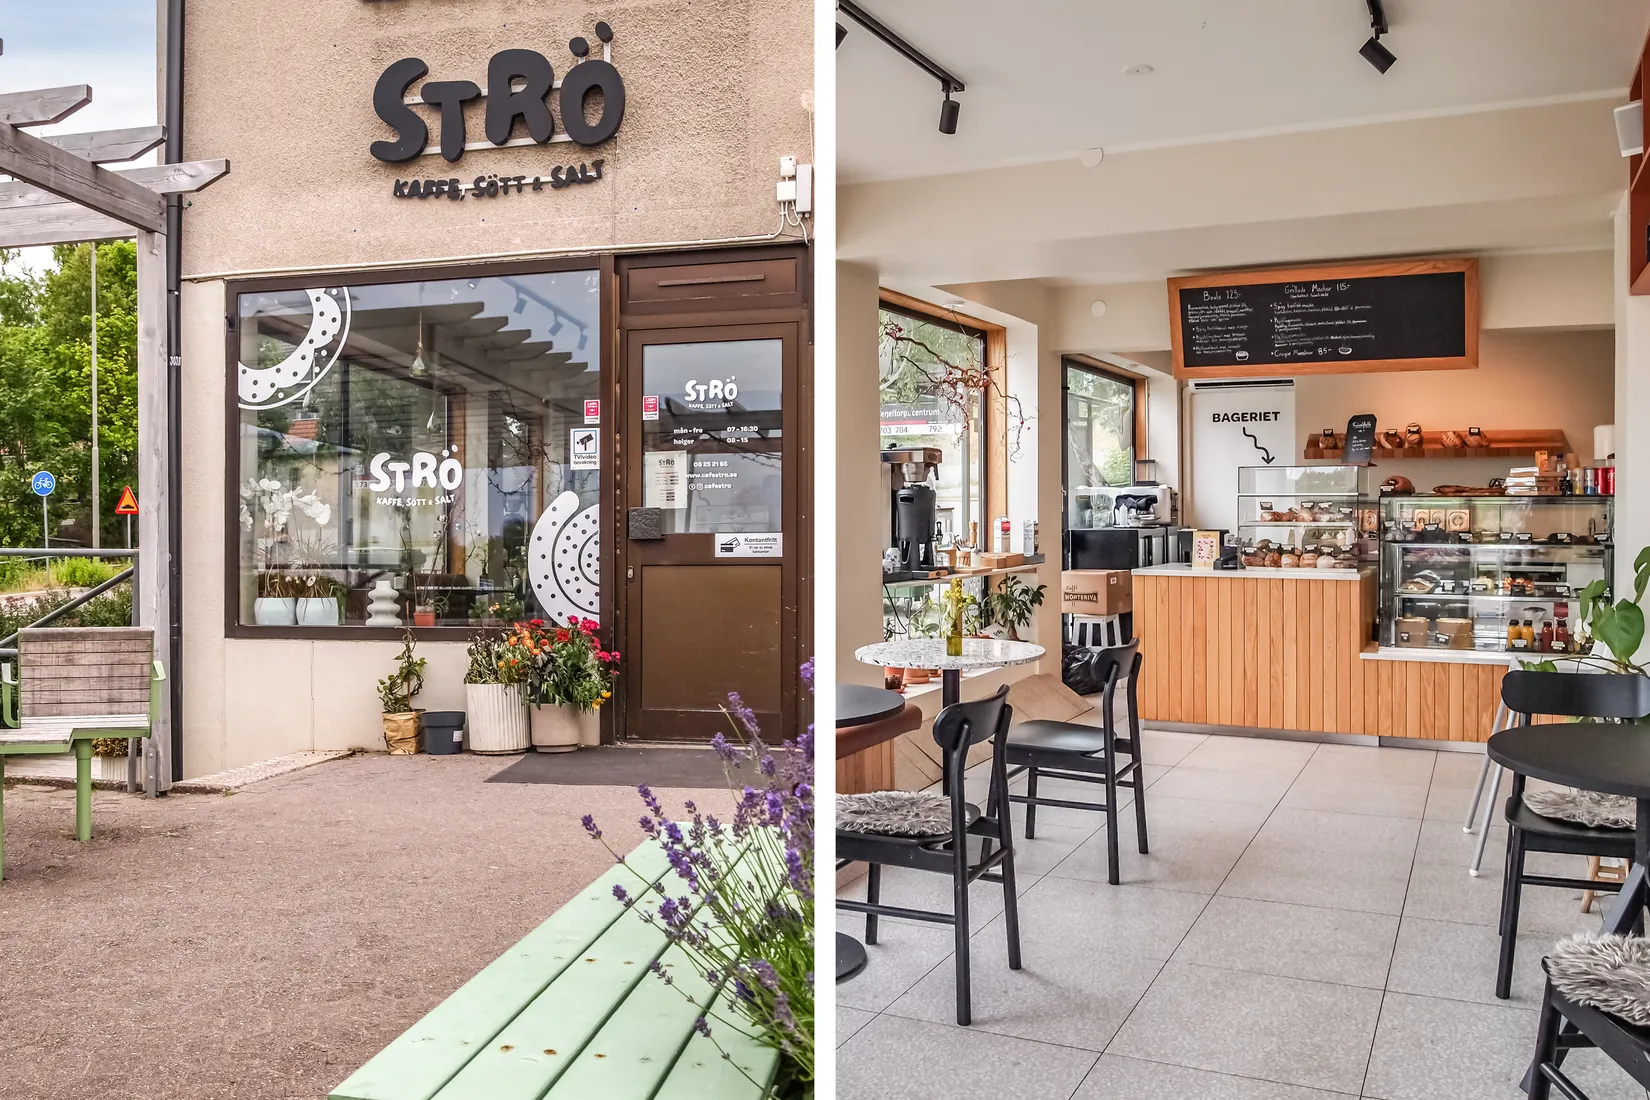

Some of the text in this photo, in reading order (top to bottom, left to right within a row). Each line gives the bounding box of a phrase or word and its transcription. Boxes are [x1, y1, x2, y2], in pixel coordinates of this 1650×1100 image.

[370, 21, 626, 163] STRÖ
[394, 159, 604, 201] KAFFE, SÖTT & SALT
[685, 375, 738, 401] STRÖ
[912, 408, 940, 416] centrum
[1212, 411, 1280, 423] BAGERIET
[673, 438, 694, 446] helger
[369, 444, 463, 493] STRÖ
[376, 496, 405, 507] KAFFE,
[406, 497, 426, 507] SÖTT
[435, 494, 455, 505] SALT
[1065, 594, 1098, 602] MONTERIVA
